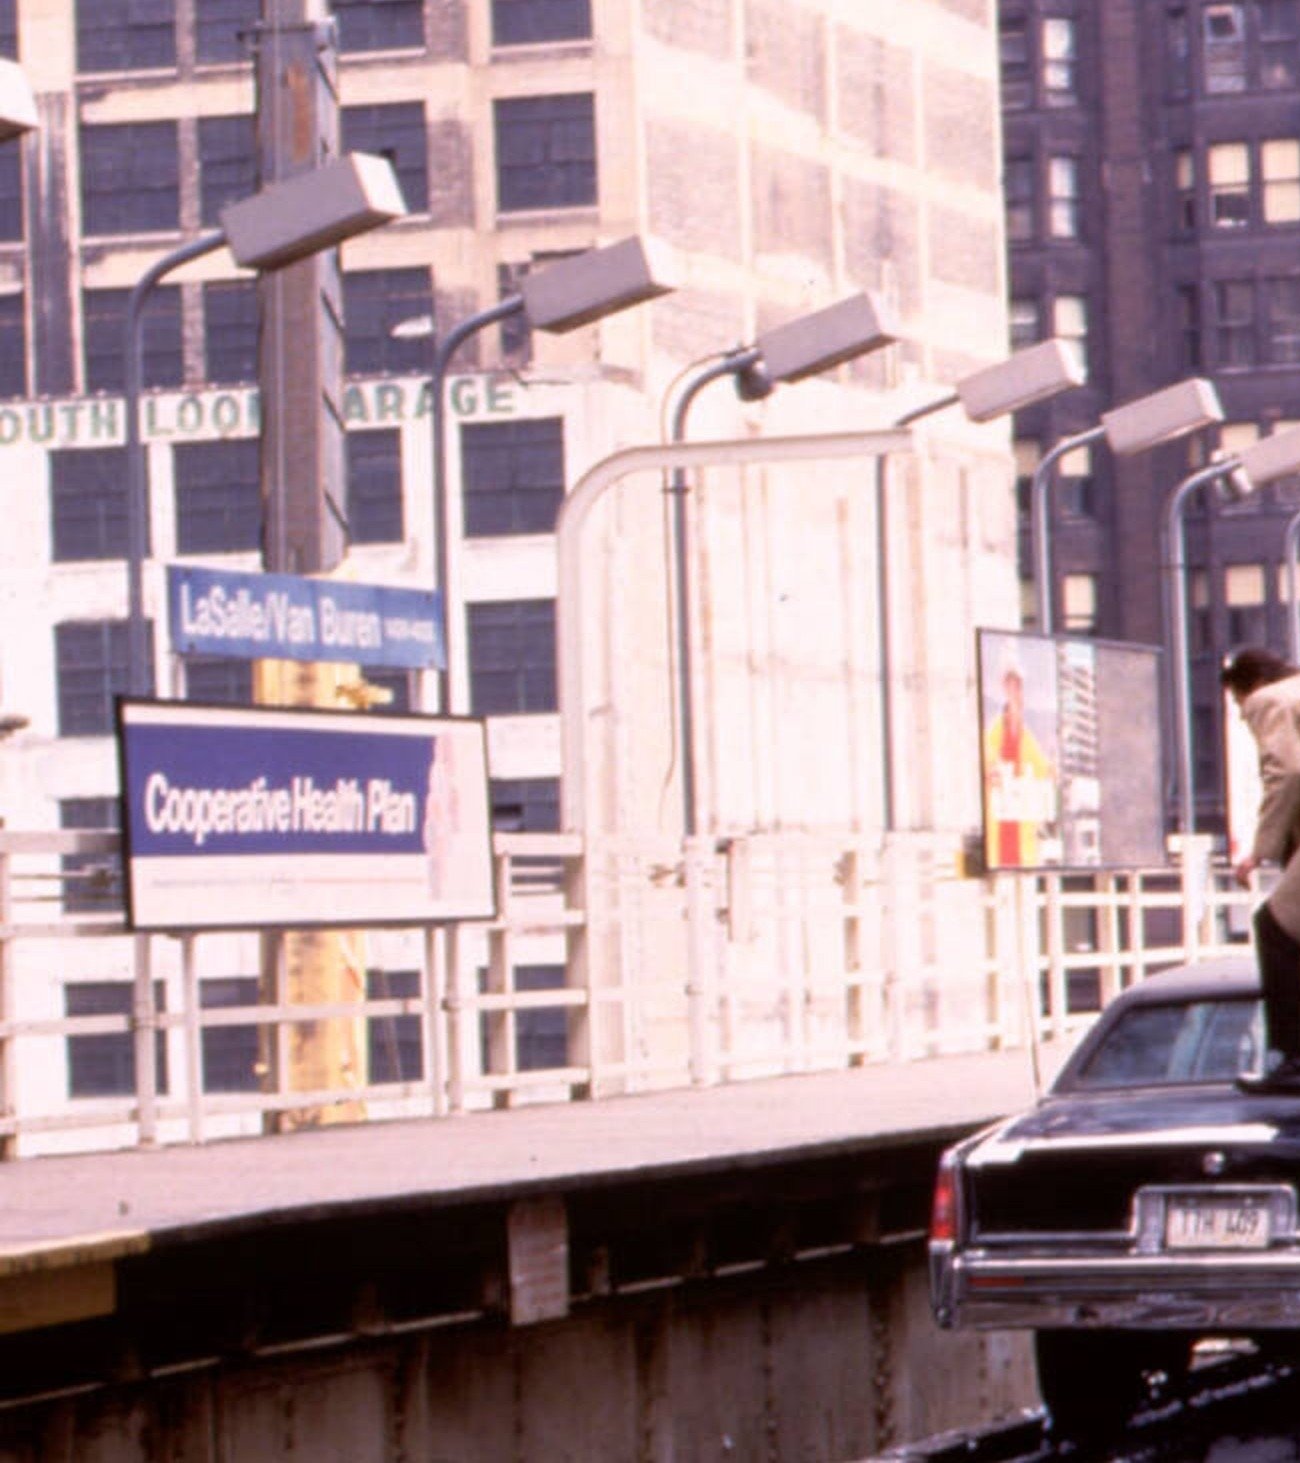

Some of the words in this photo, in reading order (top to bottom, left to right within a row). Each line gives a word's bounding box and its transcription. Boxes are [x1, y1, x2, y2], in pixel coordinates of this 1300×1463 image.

[0, 401, 117, 444] OUTH
[342, 376, 513, 422] ARAGE
[319, 596, 381, 649] Buren
[145, 772, 291, 845] Cooperative
[292, 776, 365, 833] Health
[367, 778, 416, 834] Plan
